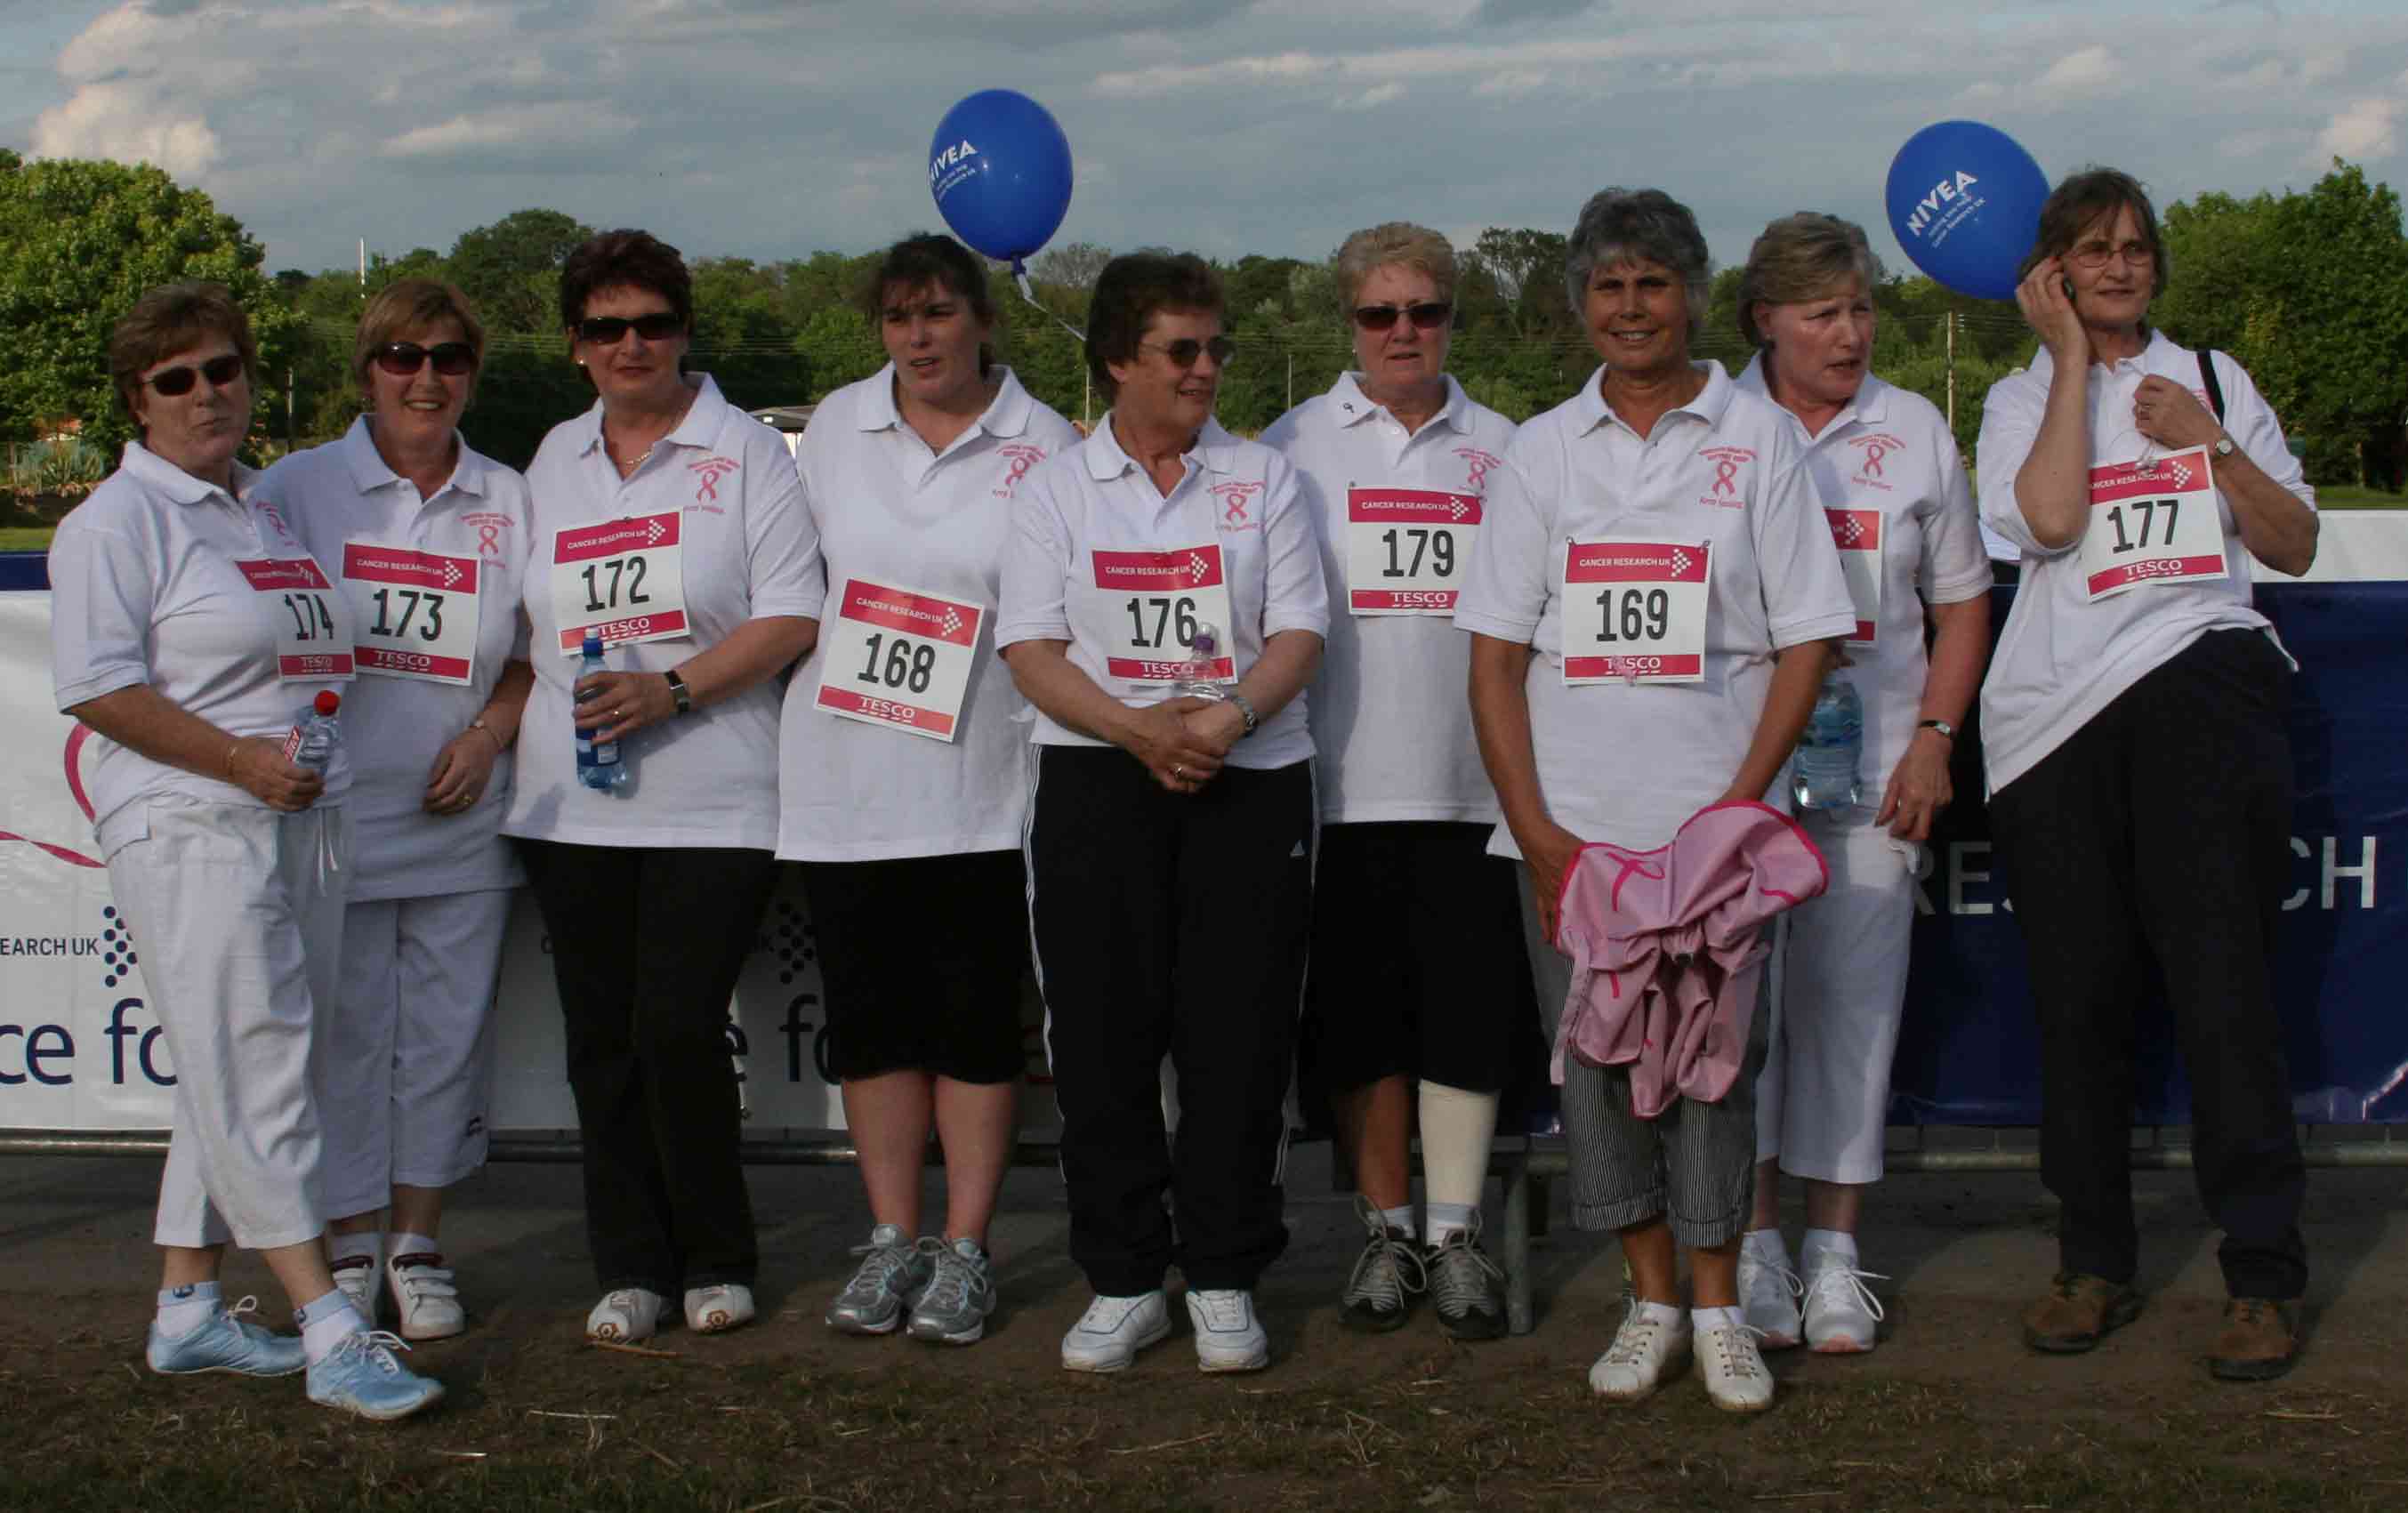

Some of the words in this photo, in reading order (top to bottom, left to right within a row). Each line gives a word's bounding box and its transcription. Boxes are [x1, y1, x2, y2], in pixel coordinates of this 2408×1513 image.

[1906, 171, 1978, 237] NIVEA
[1361, 501, 1394, 510] CANCER
[1396, 502, 1437, 511] RESEARCH
[1438, 503, 1451, 511] UK
[2107, 499, 2178, 554] 177
[568, 538, 597, 550] CANCER
[599, 531, 635, 545] RESEARCH
[636, 529, 648, 539] UK
[1382, 528, 1454, 577] 179
[1580, 559, 1611, 567] CANCER
[1614, 558, 1657, 567] RESEARCH
[1658, 559, 1671, 567] UK
[357, 559, 390, 570] CANCER
[391, 561, 431, 575] RESEARCH
[1105, 566, 1136, 576] CANCER
[1139, 567, 1179, 576] RESEARCH
[1180, 565, 1189, 575] UK
[2122, 559, 2183, 576] TESCO
[581, 556, 649, 612] 172
[1390, 592, 1448, 603] TESCO
[284, 593, 334, 640] 174
[370, 588, 444, 640] 173
[856, 597, 889, 612] CANCER
[890, 604, 930, 621] RESEARCH
[931, 611, 944, 624] UK
[1596, 588, 1669, 642] 169
[599, 617, 650, 636] TESCO
[1126, 597, 1197, 648] 176
[374, 649, 431, 667] TESCO
[858, 632, 937, 694] 168
[1140, 661, 1195, 674] TESCO
[860, 695, 915, 719] TESCO
[0, 938, 67, 956] EARCH
[73, 938, 100, 956] UK
